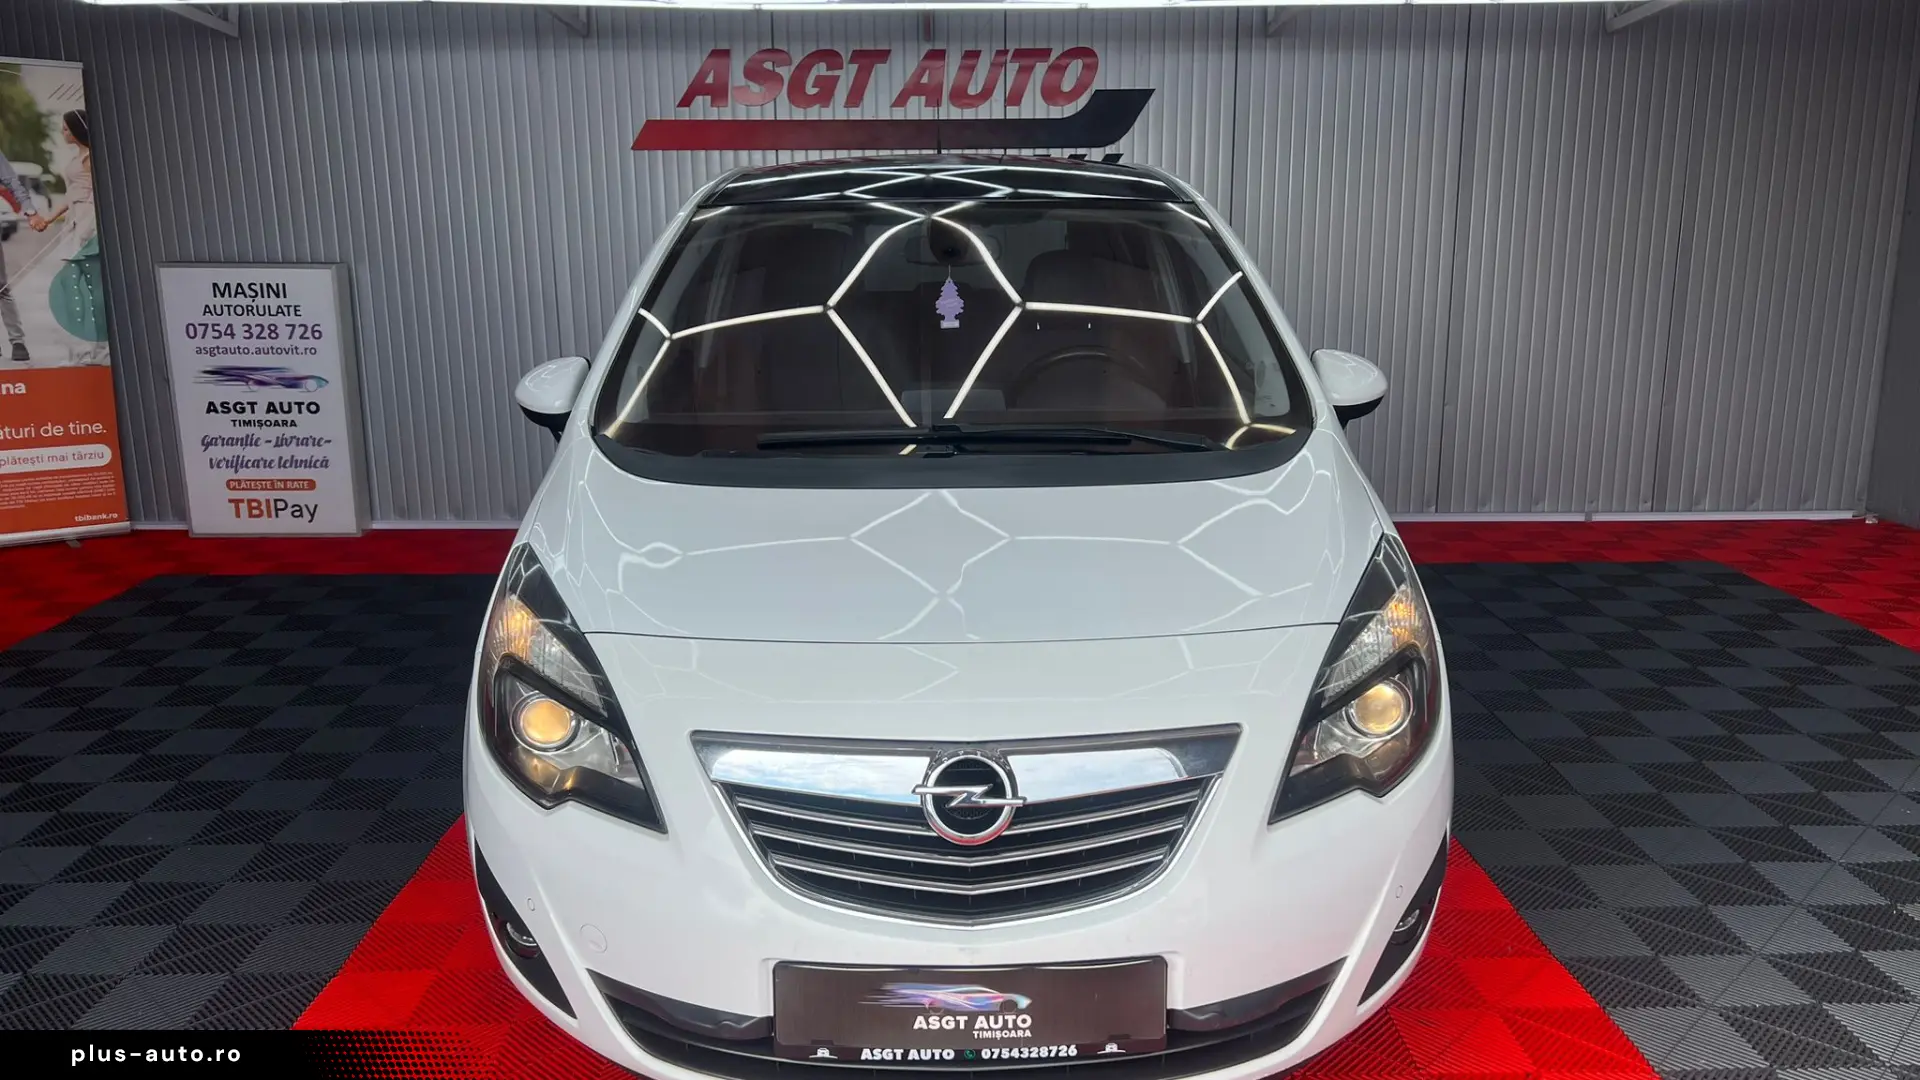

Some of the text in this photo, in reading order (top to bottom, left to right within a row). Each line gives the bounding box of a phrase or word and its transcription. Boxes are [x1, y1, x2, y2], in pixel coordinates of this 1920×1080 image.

[676, 46, 1100, 109] ASGT AUTO
[212, 282, 288, 303] MAȘINI
[202, 304, 303, 318] AUTORULATE
[185, 322, 324, 341] 0754 328 726
[195, 343, 318, 358] asgtauto.autovit.ro
[205, 400, 321, 416] ASGT AUTO
[40, 421, 64, 437] de
[68, 420, 107, 436] tine.
[230, 419, 298, 430] TIMIȘOARA
[47, 451, 69, 463] mai
[71, 450, 105, 462] târziu
[208, 454, 330, 474] Verificare tehnică
[286, 480, 309, 490] RATE
[74, 513, 118, 522] tbibank.ro
[227, 498, 319, 524] TBIPay
[912, 1014, 1033, 1031] ASGT AUTO
[972, 1030, 1032, 1040] TIMIȘOARA
[860, 1045, 1078, 1061] ASGT AUTO 0754328726
